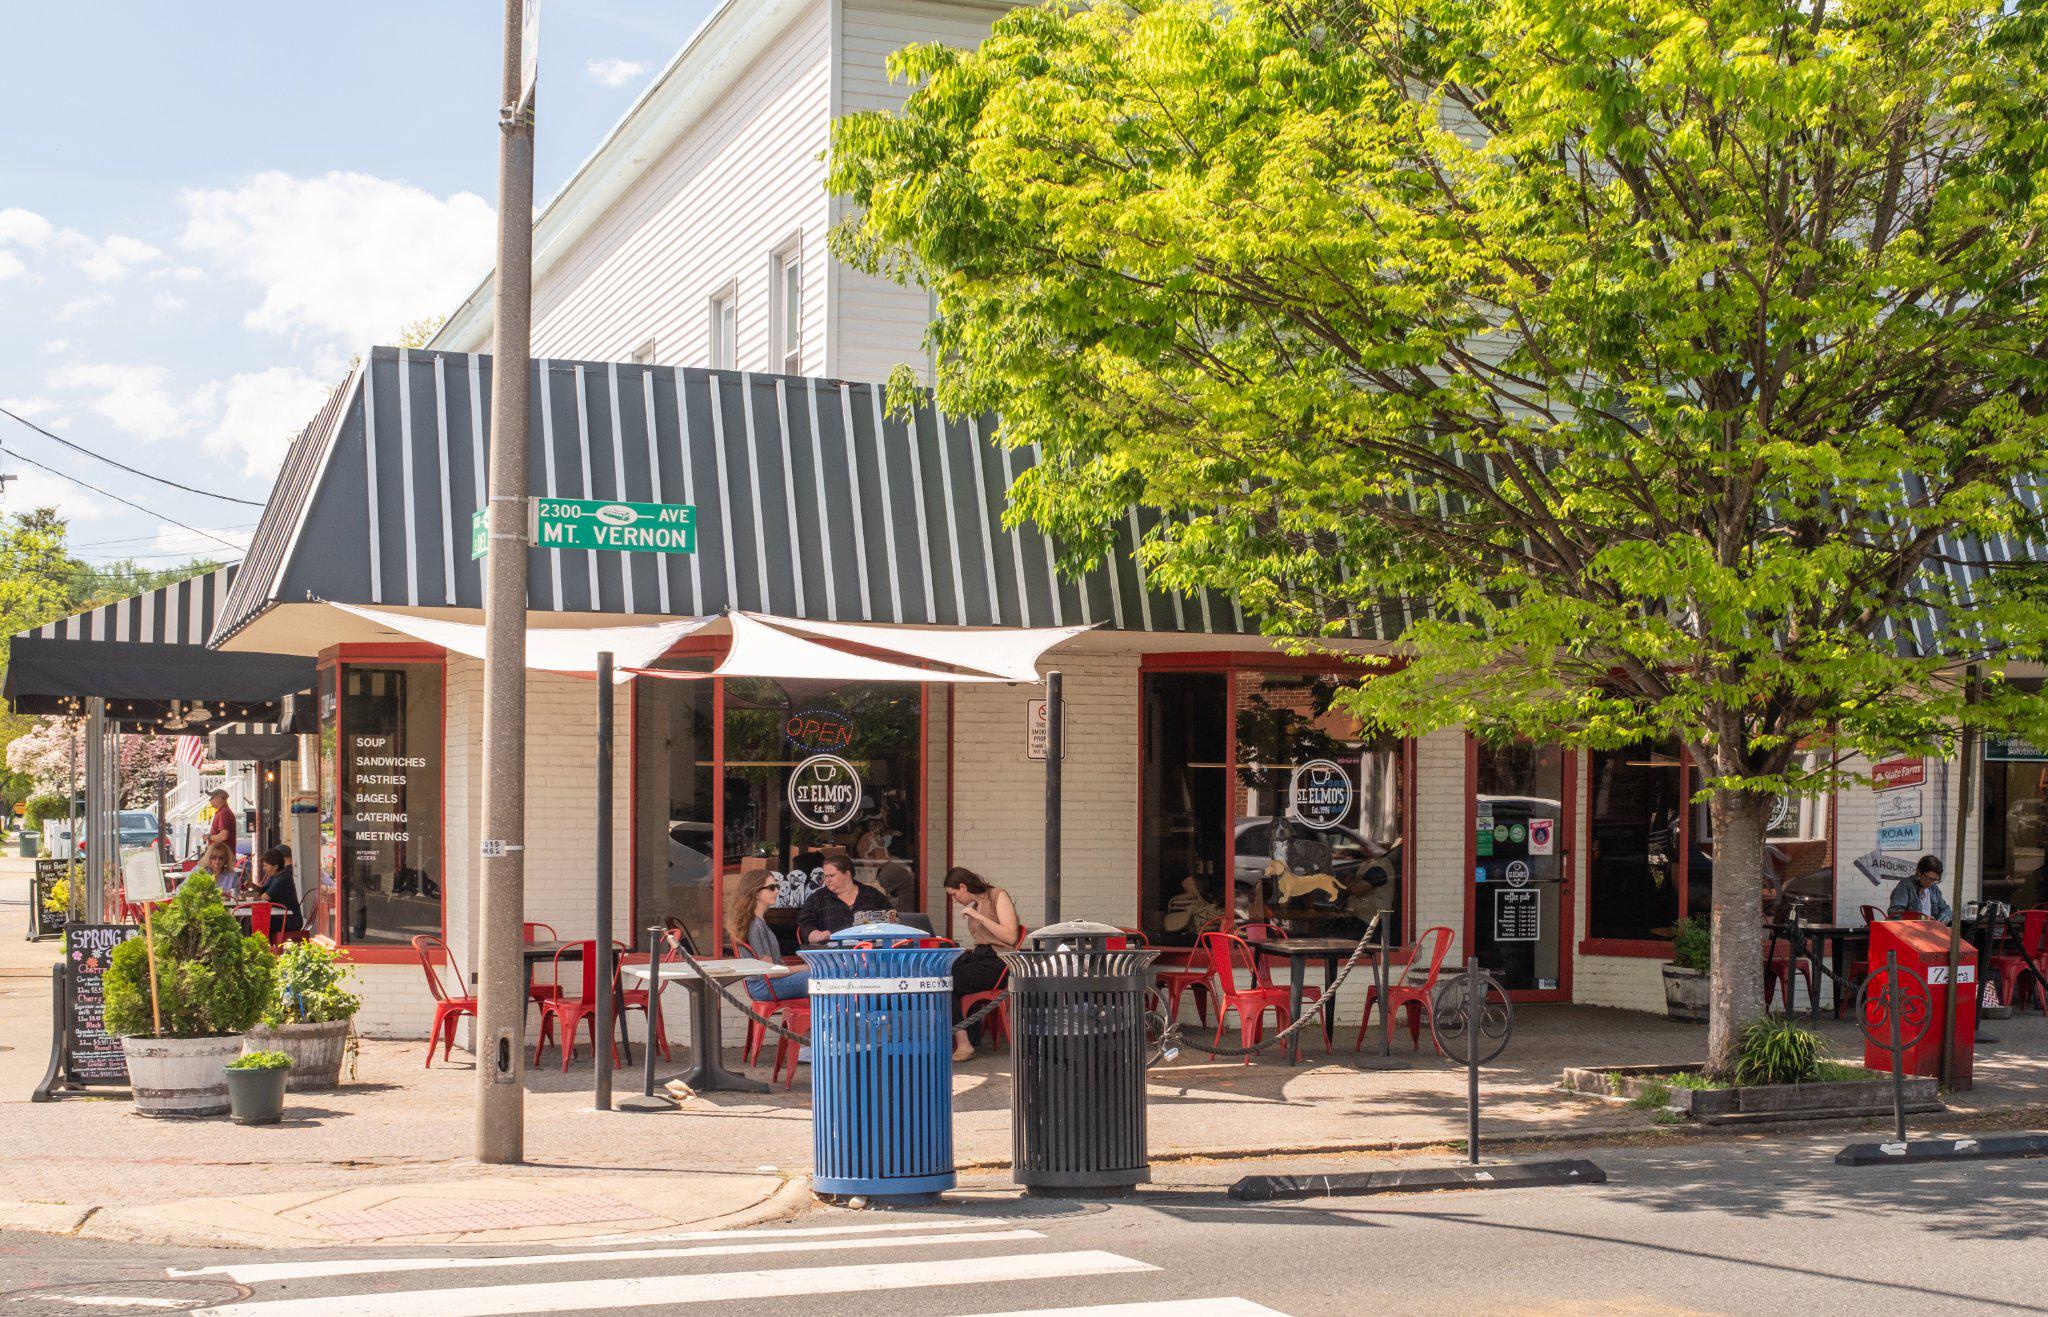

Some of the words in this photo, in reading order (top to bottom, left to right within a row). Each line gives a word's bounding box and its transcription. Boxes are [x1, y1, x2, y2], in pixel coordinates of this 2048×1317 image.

[540, 503, 581, 518] 2300
[658, 508, 689, 523] AVE
[544, 522, 580, 544] MT.
[593, 525, 686, 548] VERNON
[786, 716, 854, 745] OPEN
[356, 737, 386, 747] SOUP
[2007, 746, 2042, 756] Solutions
[356, 757, 426, 768] SANDWICHES
[1884, 769, 1901, 780] State
[1902, 765, 1922, 777] Farm
[356, 775, 407, 785] PASTRIES
[356, 794, 398, 804] BAGELS
[810, 784, 853, 803] ELMO'S
[1308, 787, 1345, 804] ELMO'S
[356, 812, 408, 823] CATERING
[355, 831, 410, 841] MEETINGS
[1881, 828, 1914, 839] ROAM
[1871, 859, 1909, 873] AROUND
[71, 928, 122, 951] SPRING
